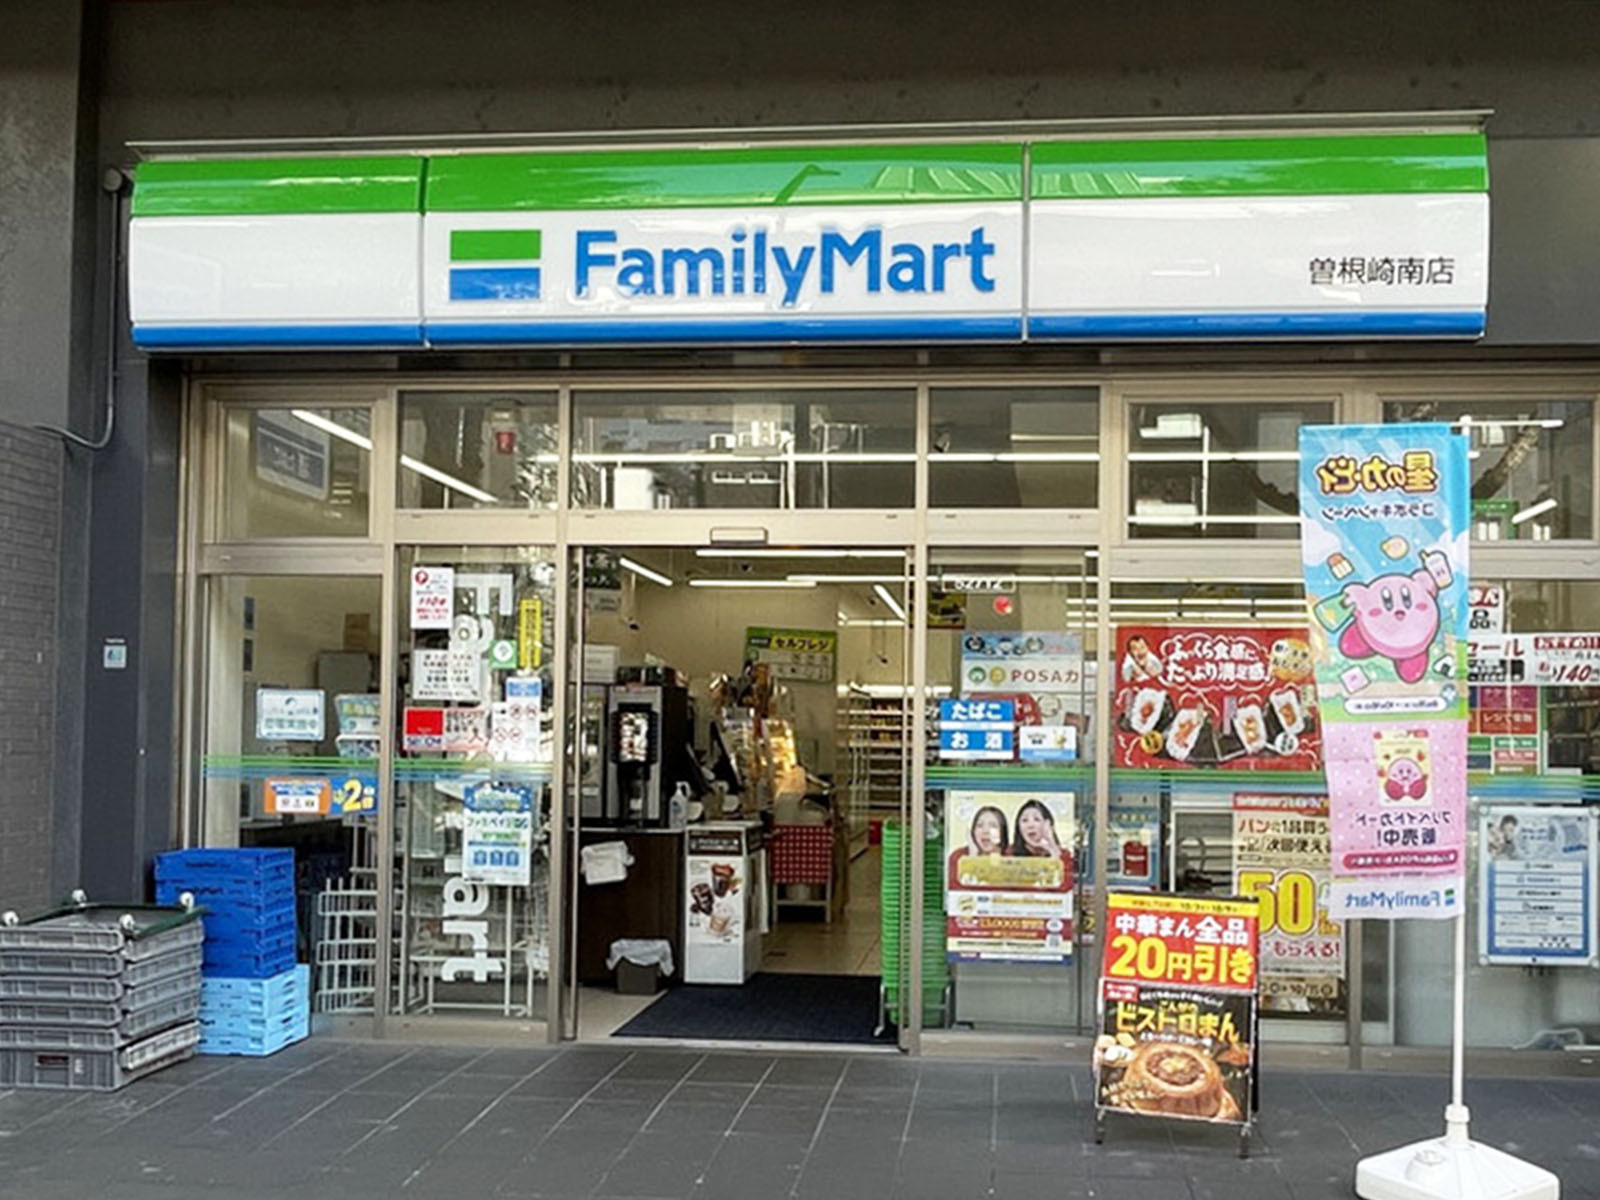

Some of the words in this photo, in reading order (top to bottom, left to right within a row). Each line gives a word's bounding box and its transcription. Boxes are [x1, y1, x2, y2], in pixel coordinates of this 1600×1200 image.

[576, 224, 996, 308] FamilyMart
[1309, 256, 1455, 285] 曽根崎南店
[951, 702, 1003, 721] たばこ
[1115, 912, 1249, 945] 中華まん全品
[1110, 935, 1254, 983] 20円引き
[1116, 1001, 1240, 1043] ビストロまん
